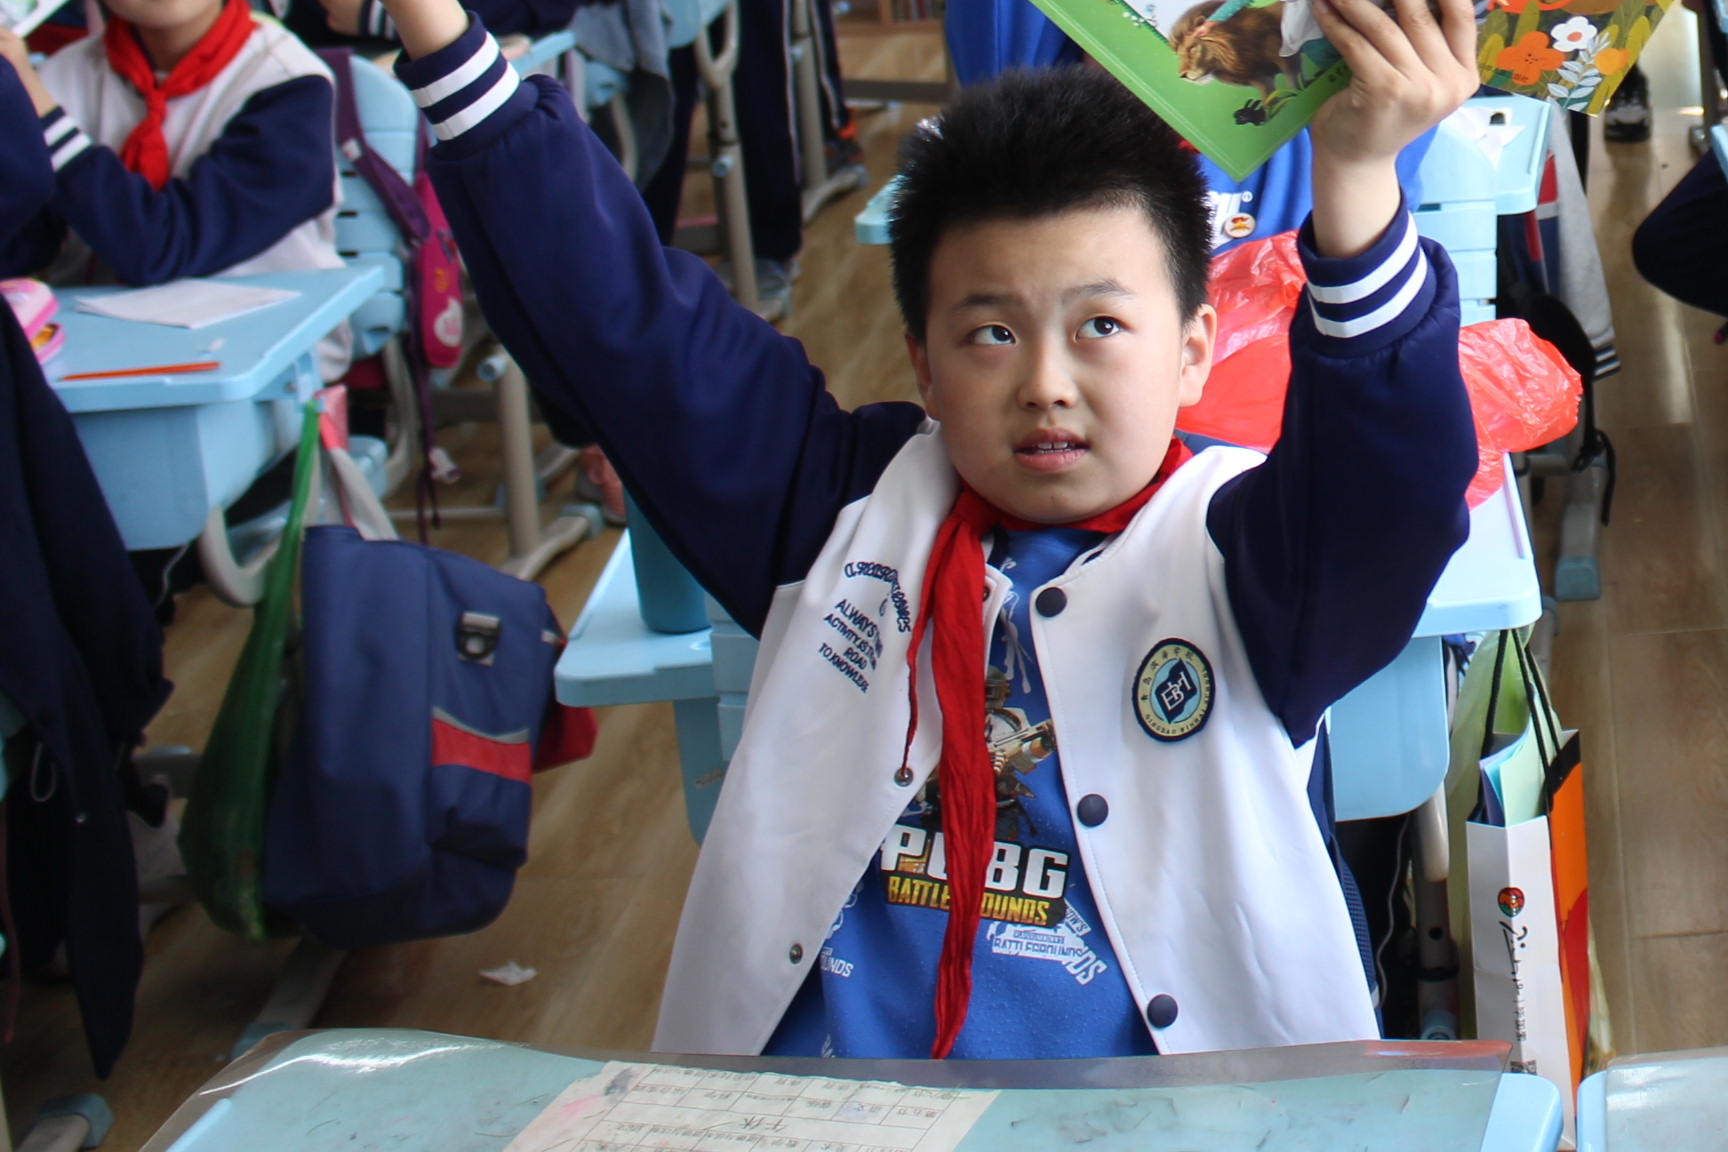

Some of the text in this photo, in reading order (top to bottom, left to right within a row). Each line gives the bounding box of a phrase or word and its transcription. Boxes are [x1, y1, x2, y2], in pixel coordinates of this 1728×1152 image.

[835, 598, 878, 638] ALWAYS
[887, 875, 1051, 926] BATTLEOUNDS
[741, 1115, 790, 1134] 午休
